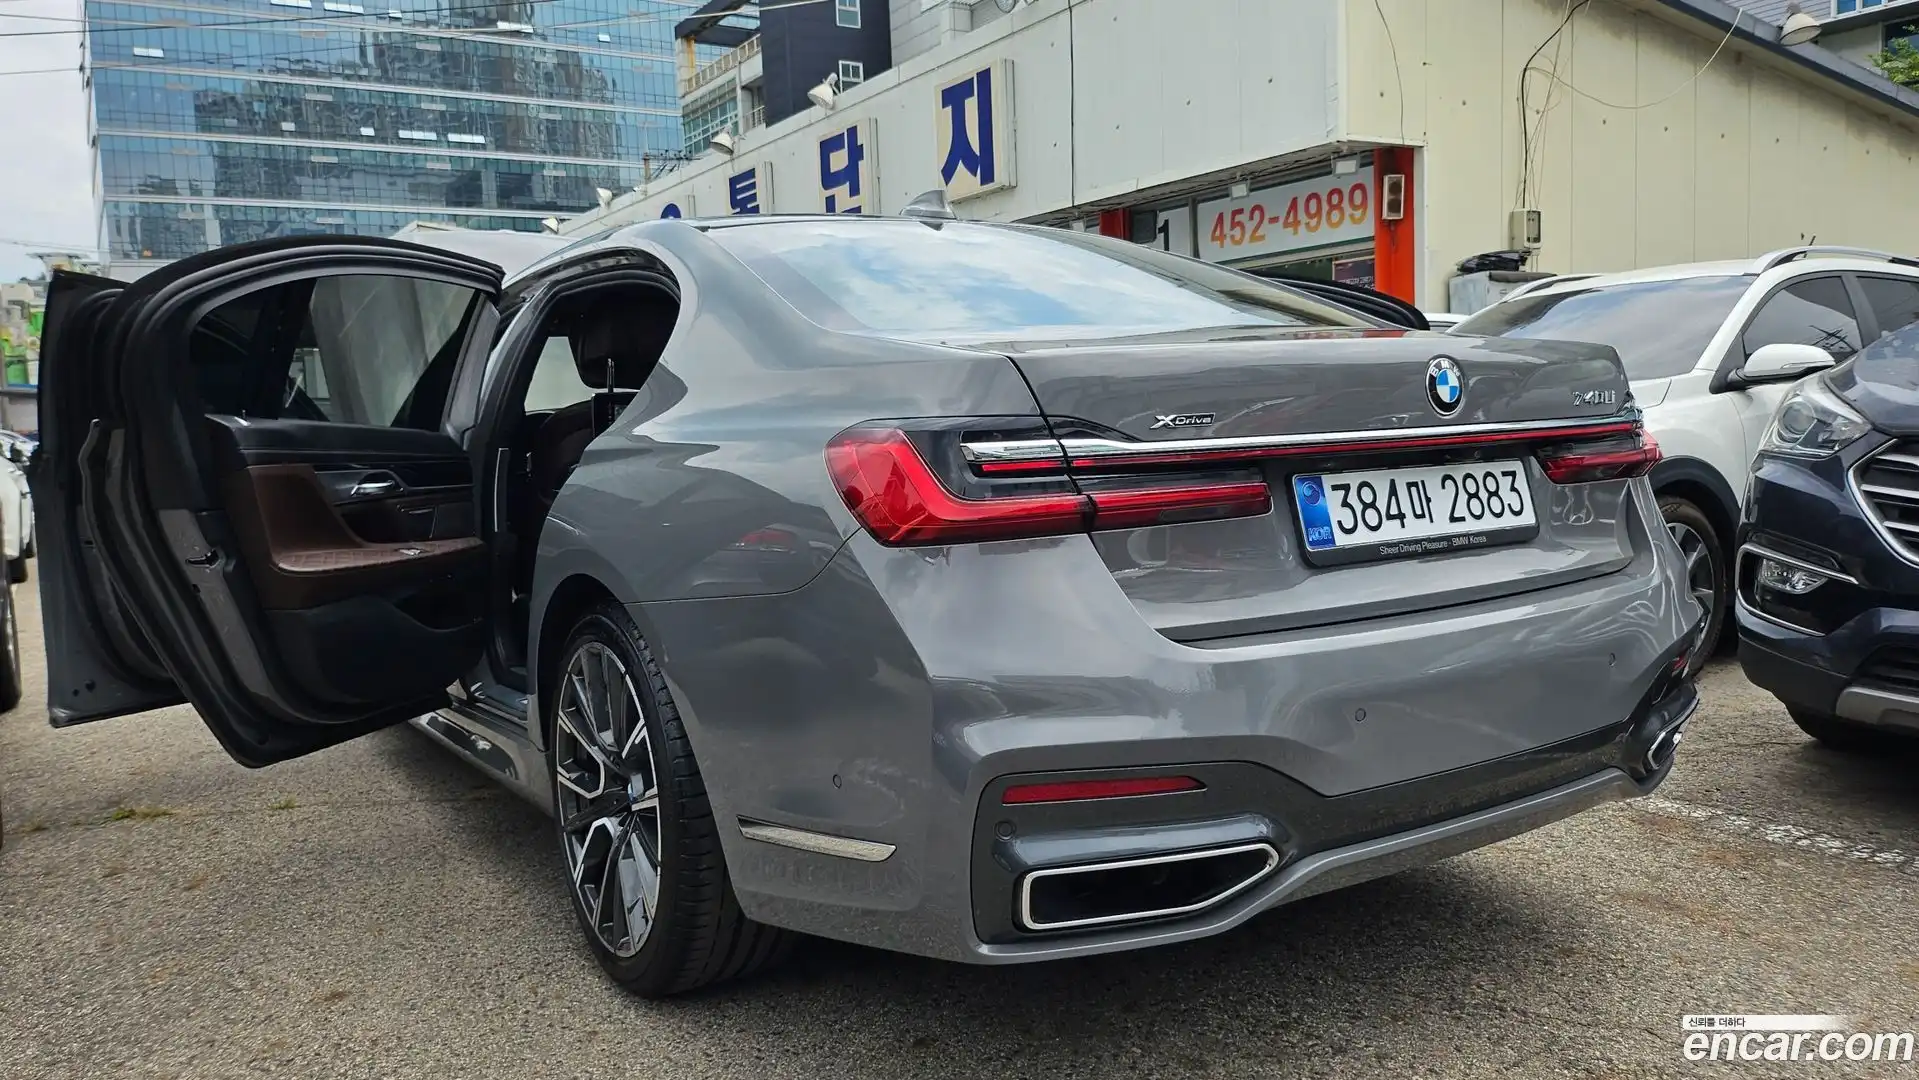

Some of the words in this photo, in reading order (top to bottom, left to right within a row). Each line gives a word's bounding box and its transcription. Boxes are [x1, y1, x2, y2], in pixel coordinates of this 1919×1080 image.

[1210, 182, 1369, 249] 452-4989
[1330, 478, 1432, 535] 384마
[1441, 470, 1525, 523] 2883
[1308, 526, 1332, 541] KOR
[1380, 545, 1399, 555] Sheer
[1400, 543, 1421, 553] Driving
[1422, 540, 1448, 550] Pleasure
[1452, 537, 1468, 546] BMW
[1470, 535, 1487, 544] Korea
